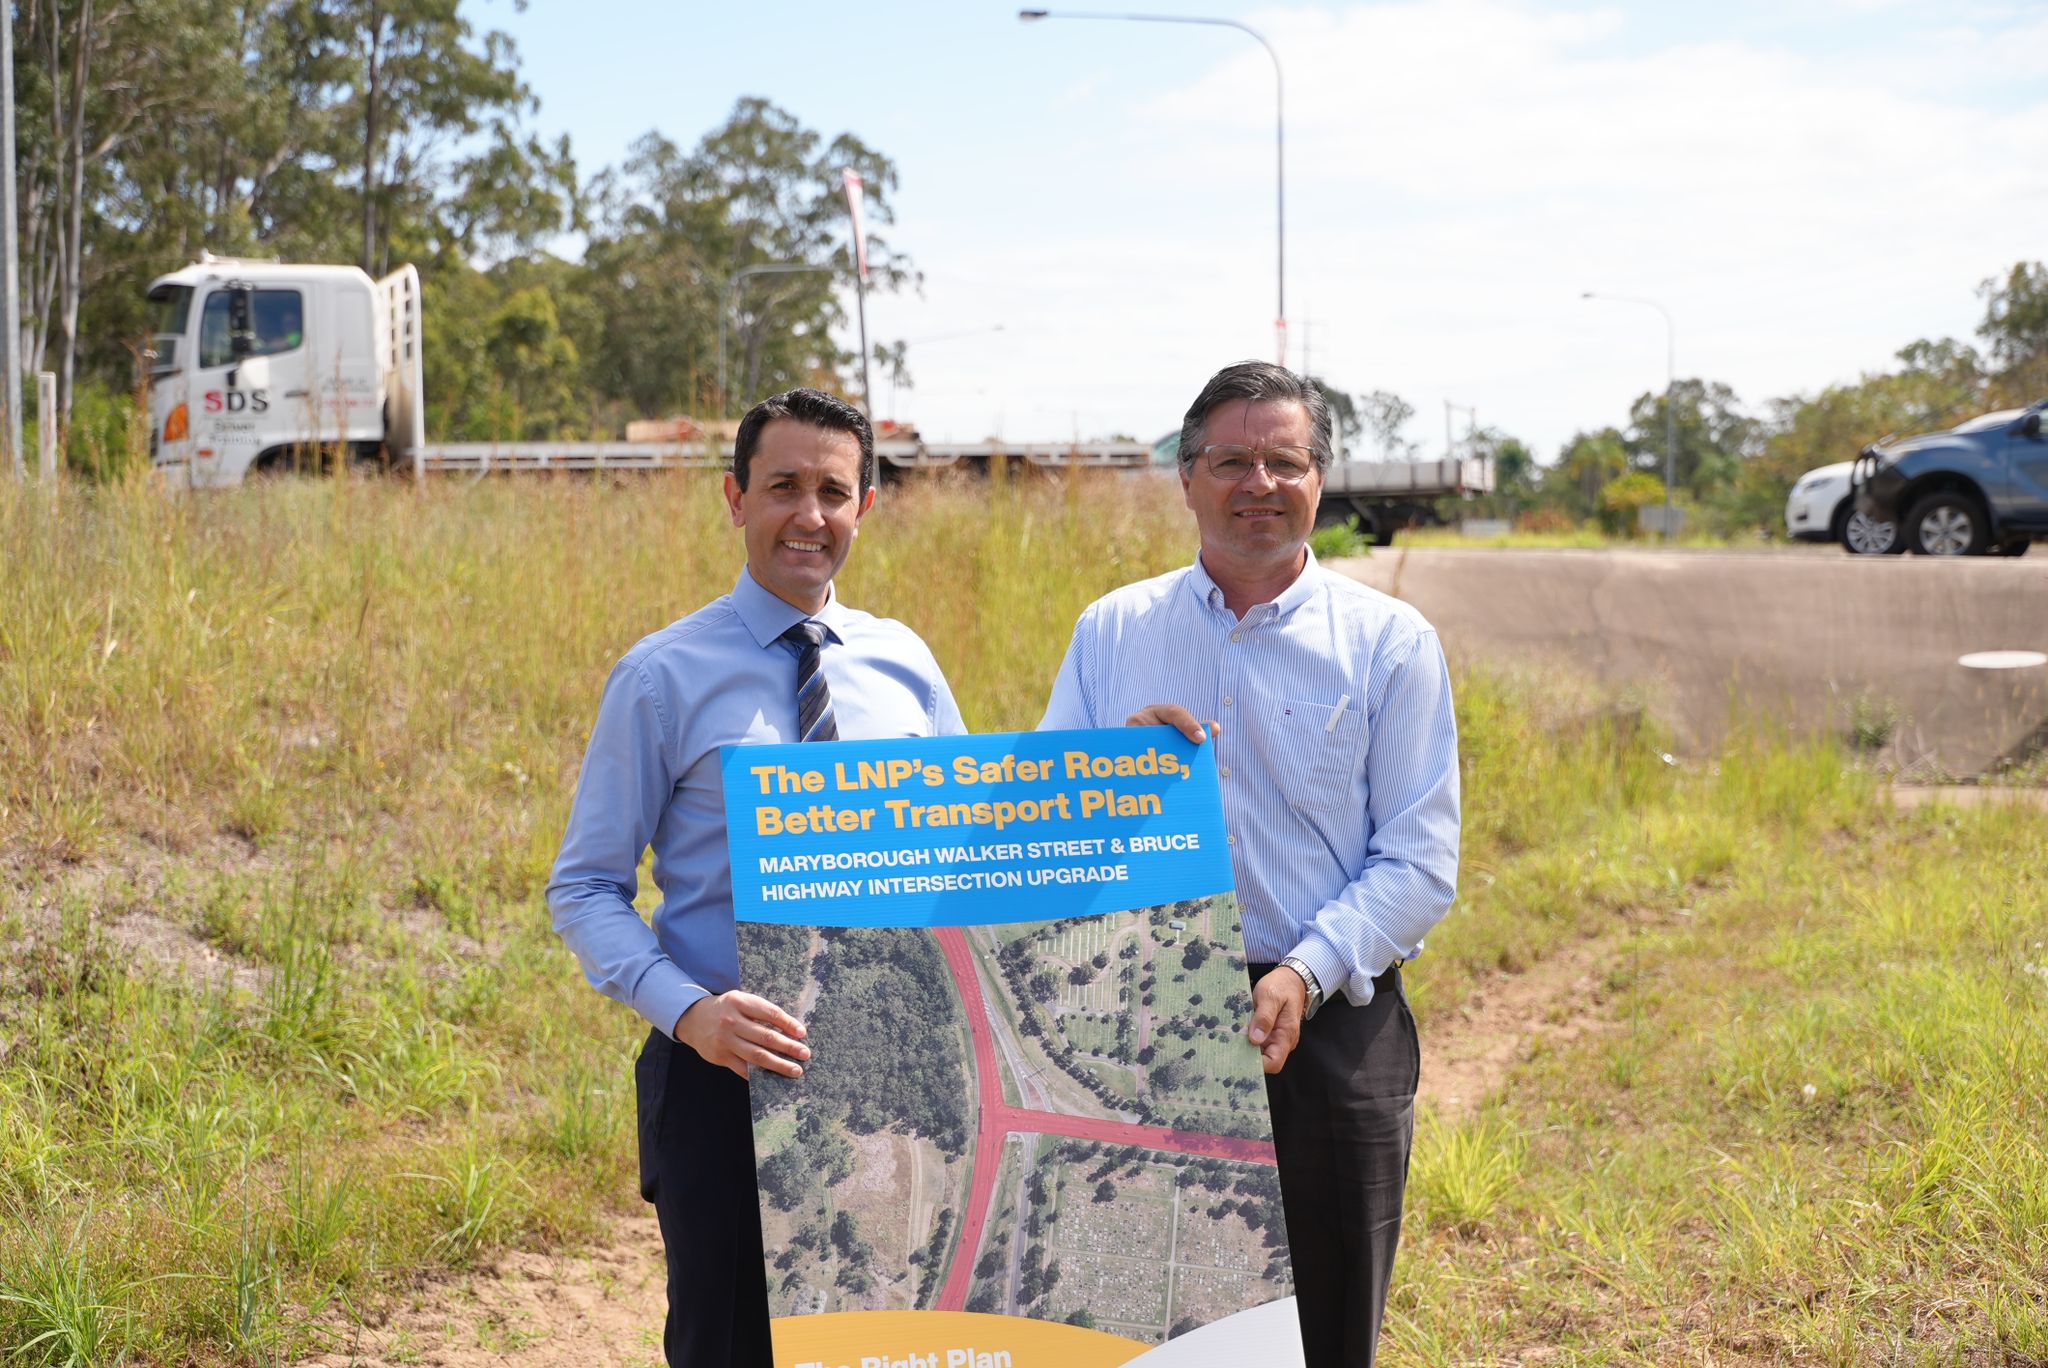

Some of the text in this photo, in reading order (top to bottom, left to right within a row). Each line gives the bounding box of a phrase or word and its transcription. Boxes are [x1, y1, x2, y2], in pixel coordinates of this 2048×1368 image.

[204, 390, 269, 413] SDS
[751, 748, 1190, 794] The LNP's Safer Roads,
[756, 789, 1162, 835] Better Transport Plan
[759, 833, 1200, 874] MARYBOROUGH WALKER STREET & BRUCE
[762, 864, 1129, 901] HIGHWAY INTERSECTION UPGRADE
[947, 1348, 1012, 1368] Plan
